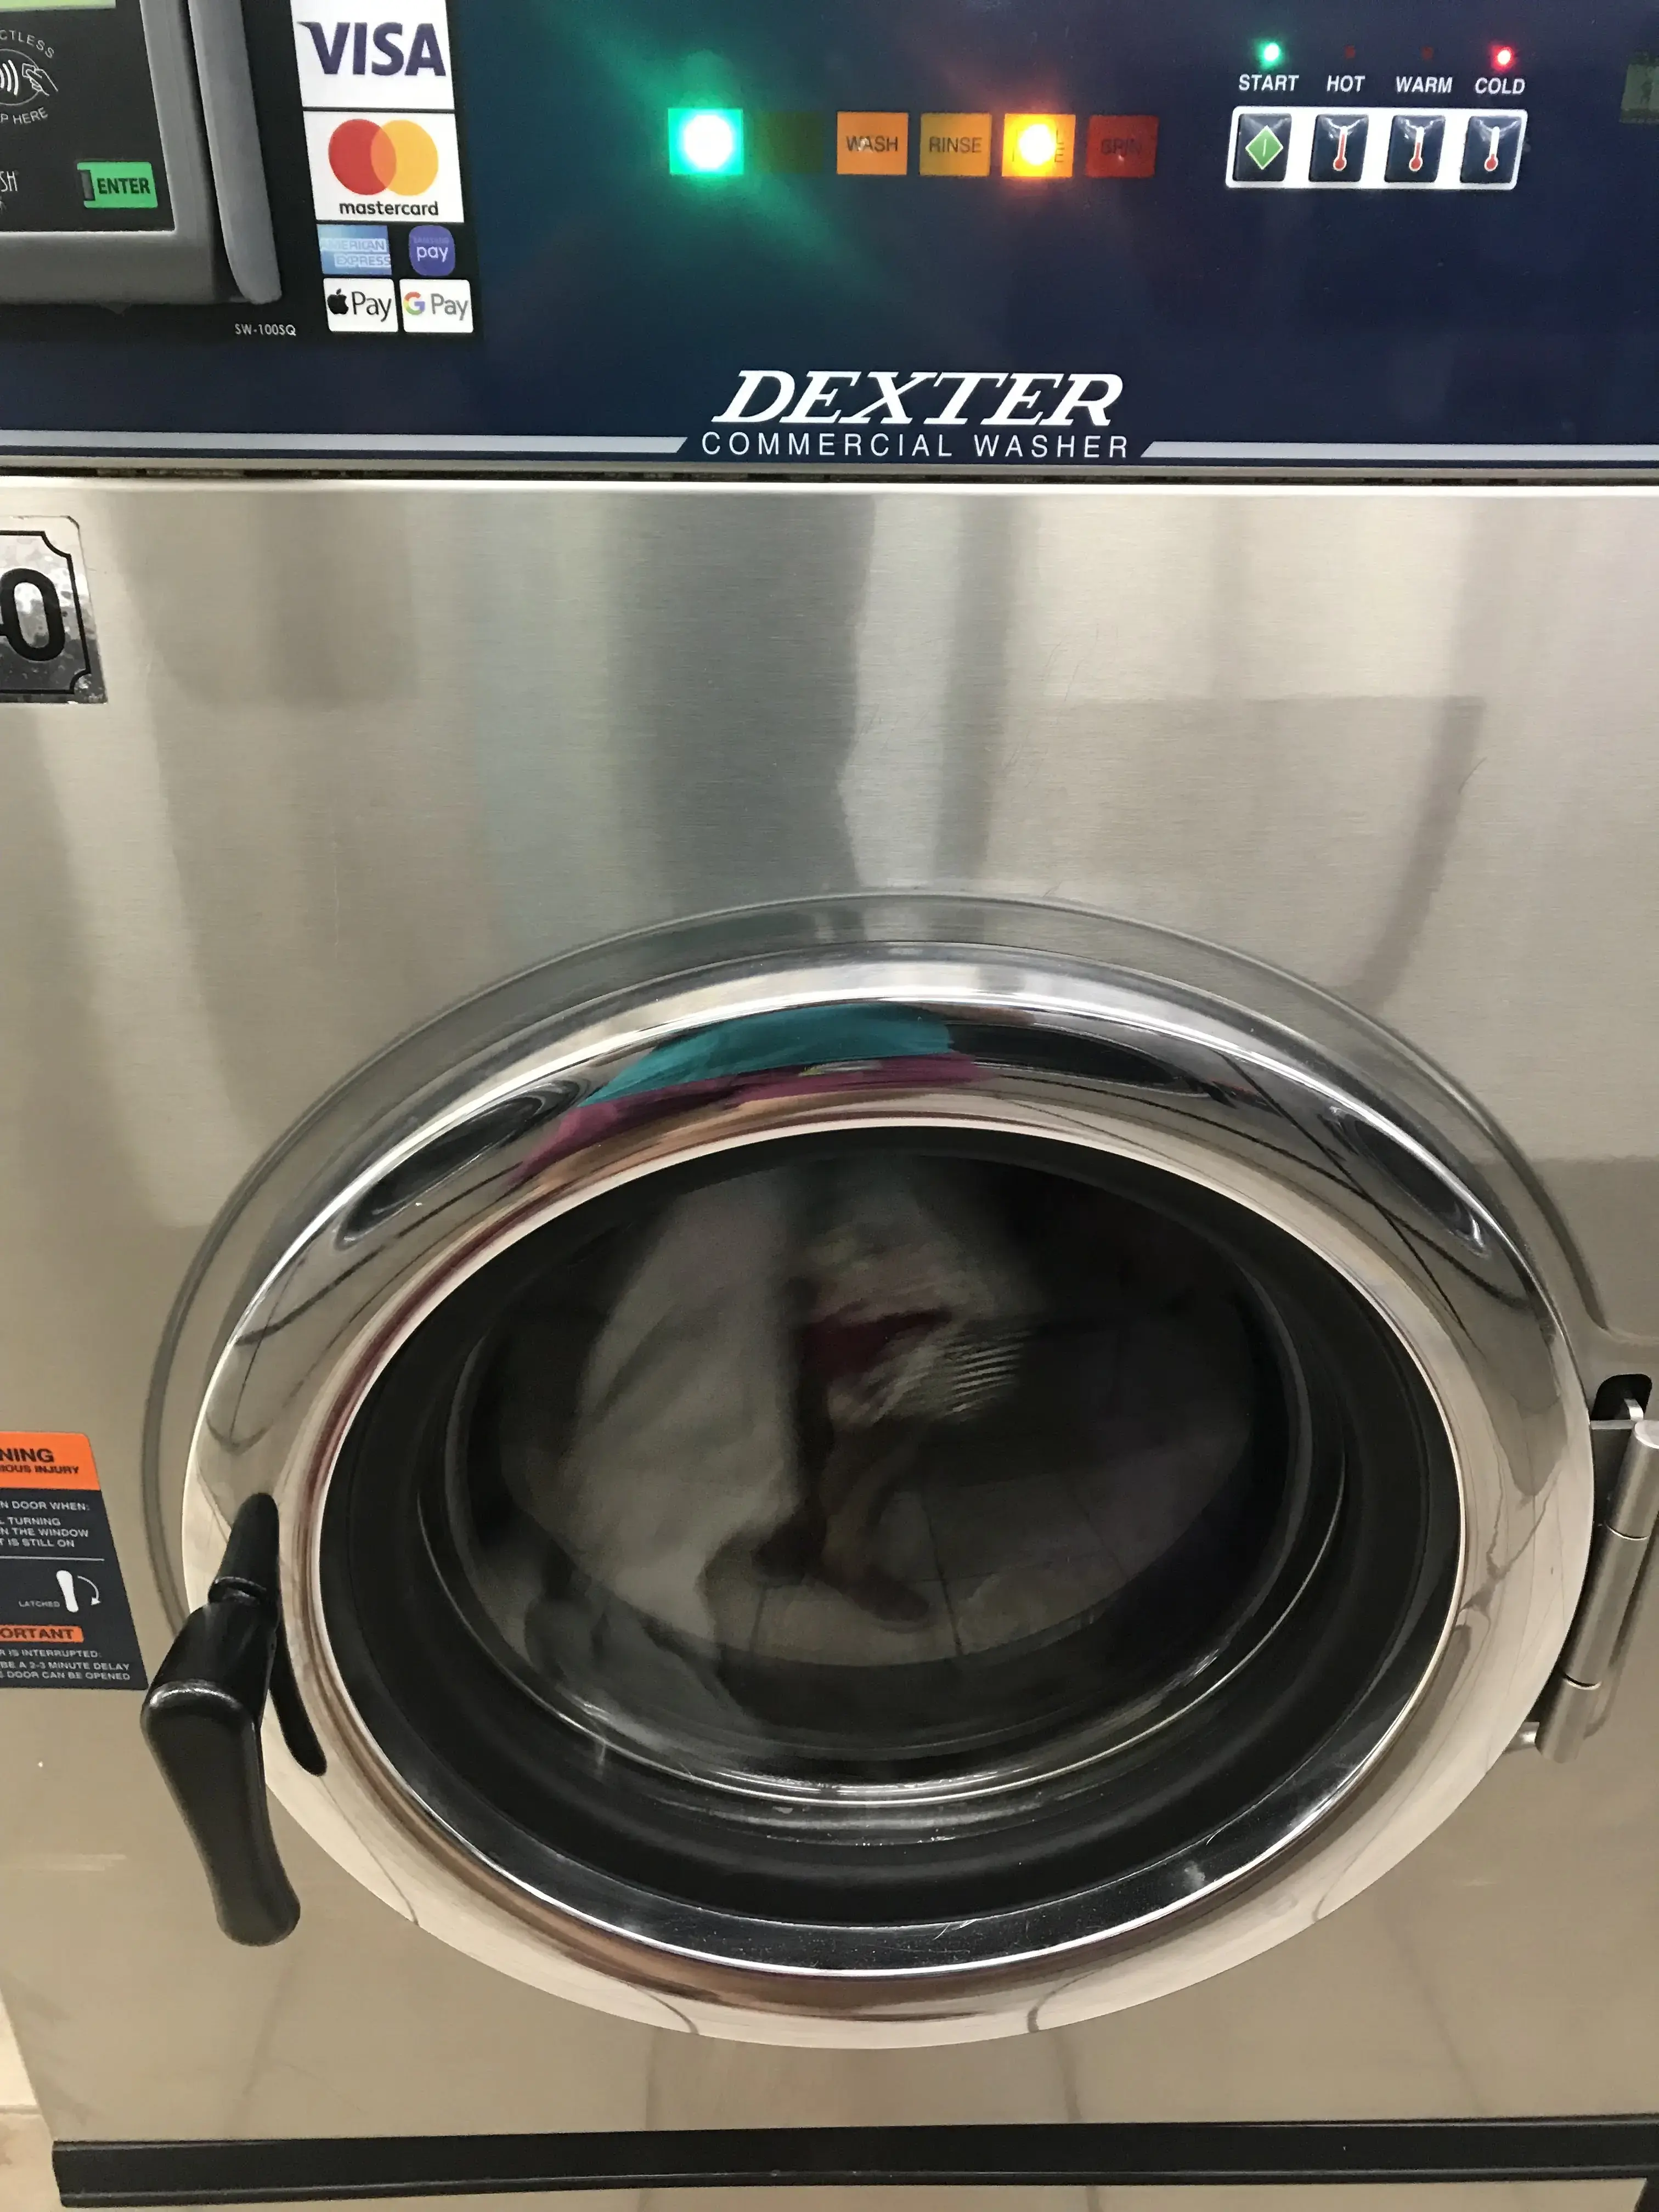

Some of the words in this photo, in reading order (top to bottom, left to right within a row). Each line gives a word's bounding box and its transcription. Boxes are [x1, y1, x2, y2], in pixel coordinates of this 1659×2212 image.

[297, 22, 446, 76] VISA
[1238, 74, 1299, 92] START
[1327, 75, 1365, 92] HOT
[1396, 76, 1453, 93] WARM
[1475, 77, 1525, 94] COLD
[13, 107, 48, 125] HERE
[846, 136, 898, 152] WASH
[929, 137, 982, 153] RINSE
[97, 177, 150, 194] ENTER
[340, 201, 439, 216] mastercard
[337, 256, 391, 266] EXPRESS
[417, 246, 448, 262] pay
[352, 291, 392, 322] Pay
[404, 292, 425, 315] G
[431, 294, 469, 320] Pay
[235, 324, 296, 336] SW-100SQ
[711, 370, 1124, 426] DEXTER
[702, 432, 952, 458] COMMERCIAL
[974, 435, 1128, 459] WASHER
[0, 568, 65, 662] 0
[35, 1465, 79, 1474] INJURY
[12, 1500, 47, 1509] DOOR
[49, 1502, 90, 1510] WHEN:
[7, 1516, 61, 1526] TURNING
[12, 1527, 35, 1536] THE
[38, 1528, 88, 1537] WINDOW
[8, 1538, 20, 1547] IS
[22, 1538, 54, 1547] STILL
[57, 1539, 75, 1547] ON
[0, 1628, 74, 1640] ORTANT
[48, 1661, 90, 1670] MINUTE
[93, 1662, 129, 1671] DELAY
[86, 1672, 130, 1680] OPENED
